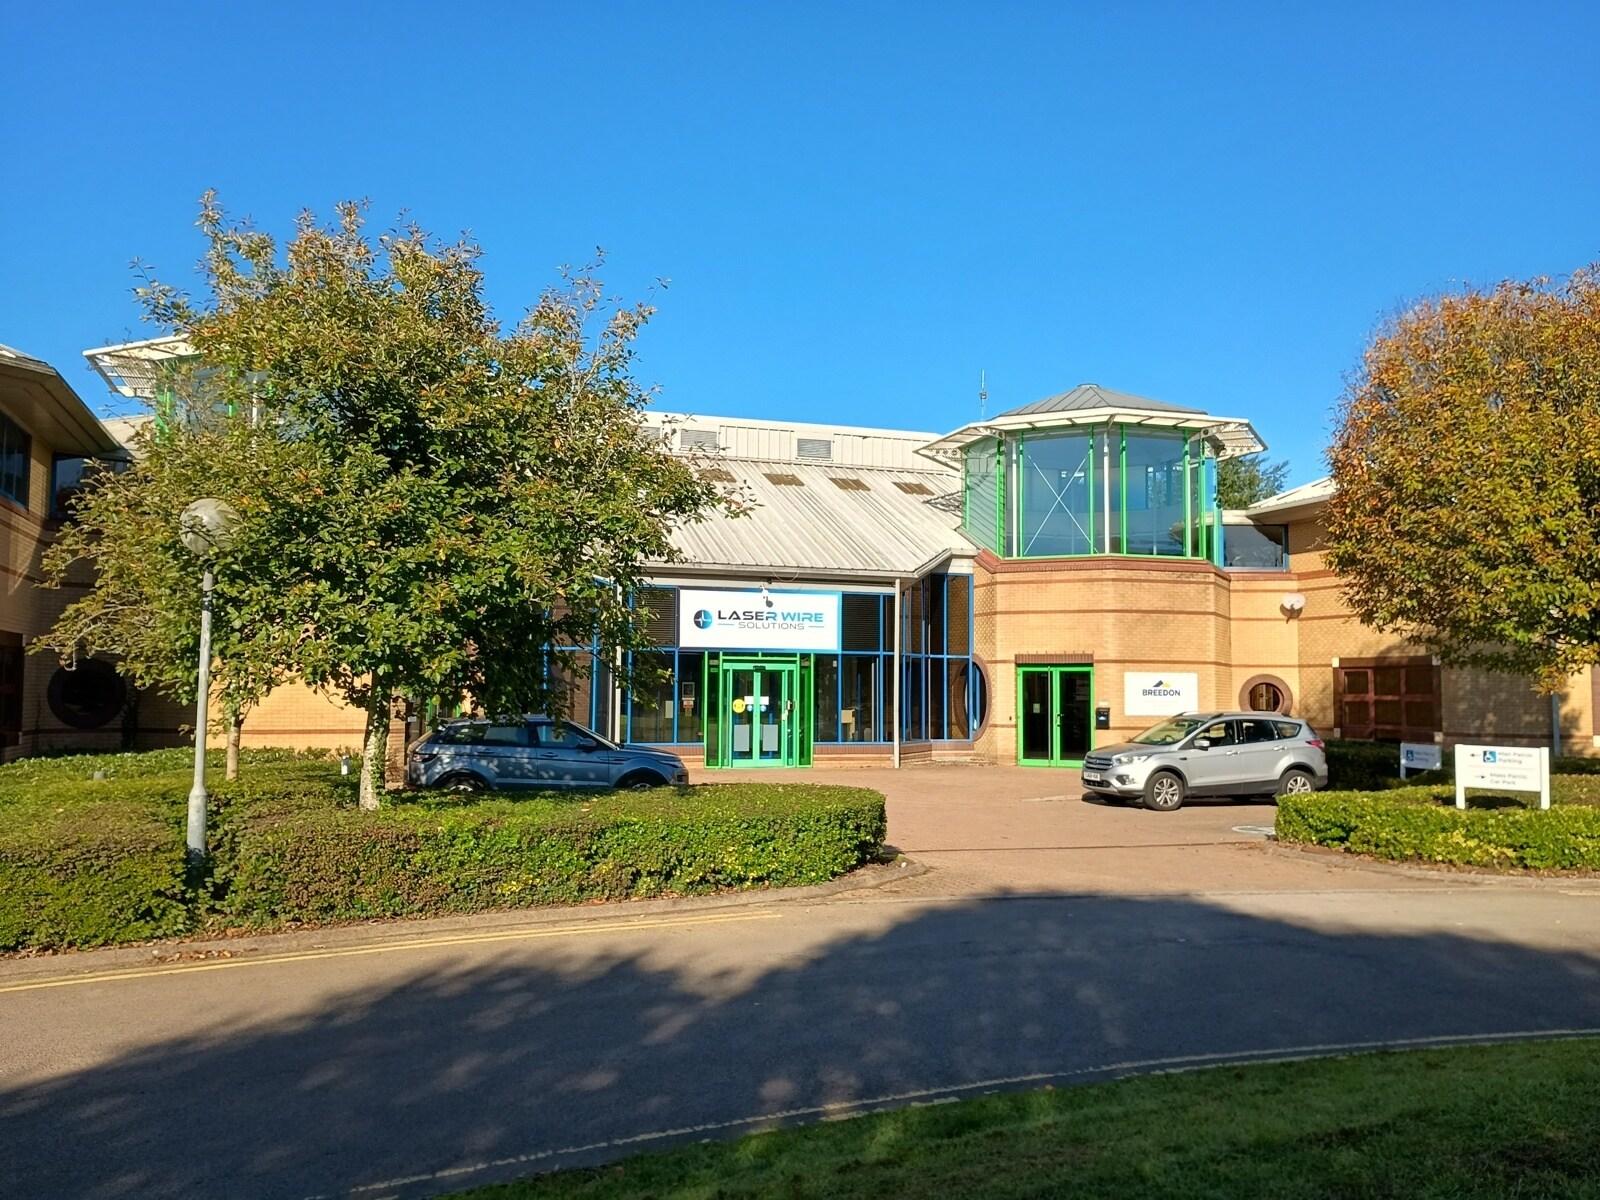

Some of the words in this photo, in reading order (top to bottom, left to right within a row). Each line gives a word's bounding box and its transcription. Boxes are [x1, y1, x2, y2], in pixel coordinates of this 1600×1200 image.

[717, 610, 777, 621] LASER
[781, 612, 824, 622] WIRE
[738, 621, 805, 630] SOLUTIONS
